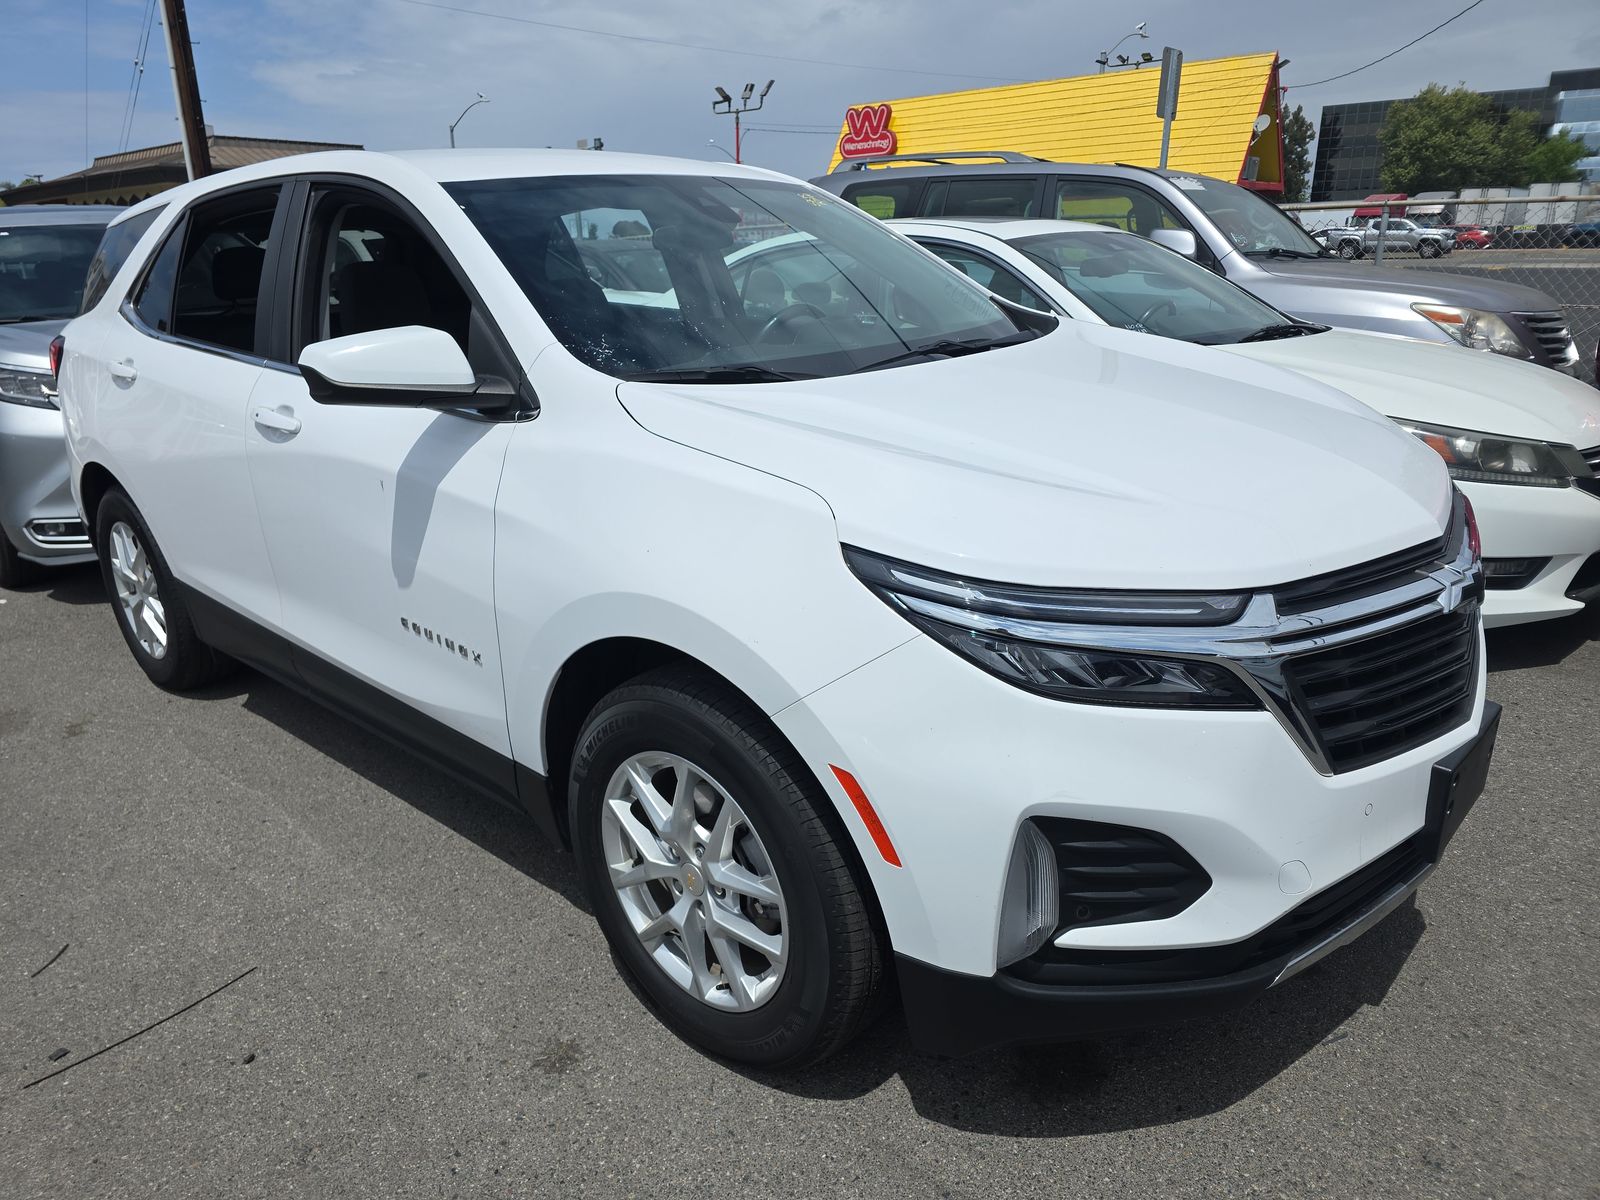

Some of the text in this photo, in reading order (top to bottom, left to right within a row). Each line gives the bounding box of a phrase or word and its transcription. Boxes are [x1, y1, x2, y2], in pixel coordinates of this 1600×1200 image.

[847, 105, 888, 140] W
[400, 616, 482, 668] EQUINOX
[585, 715, 636, 758] MICHELIN
